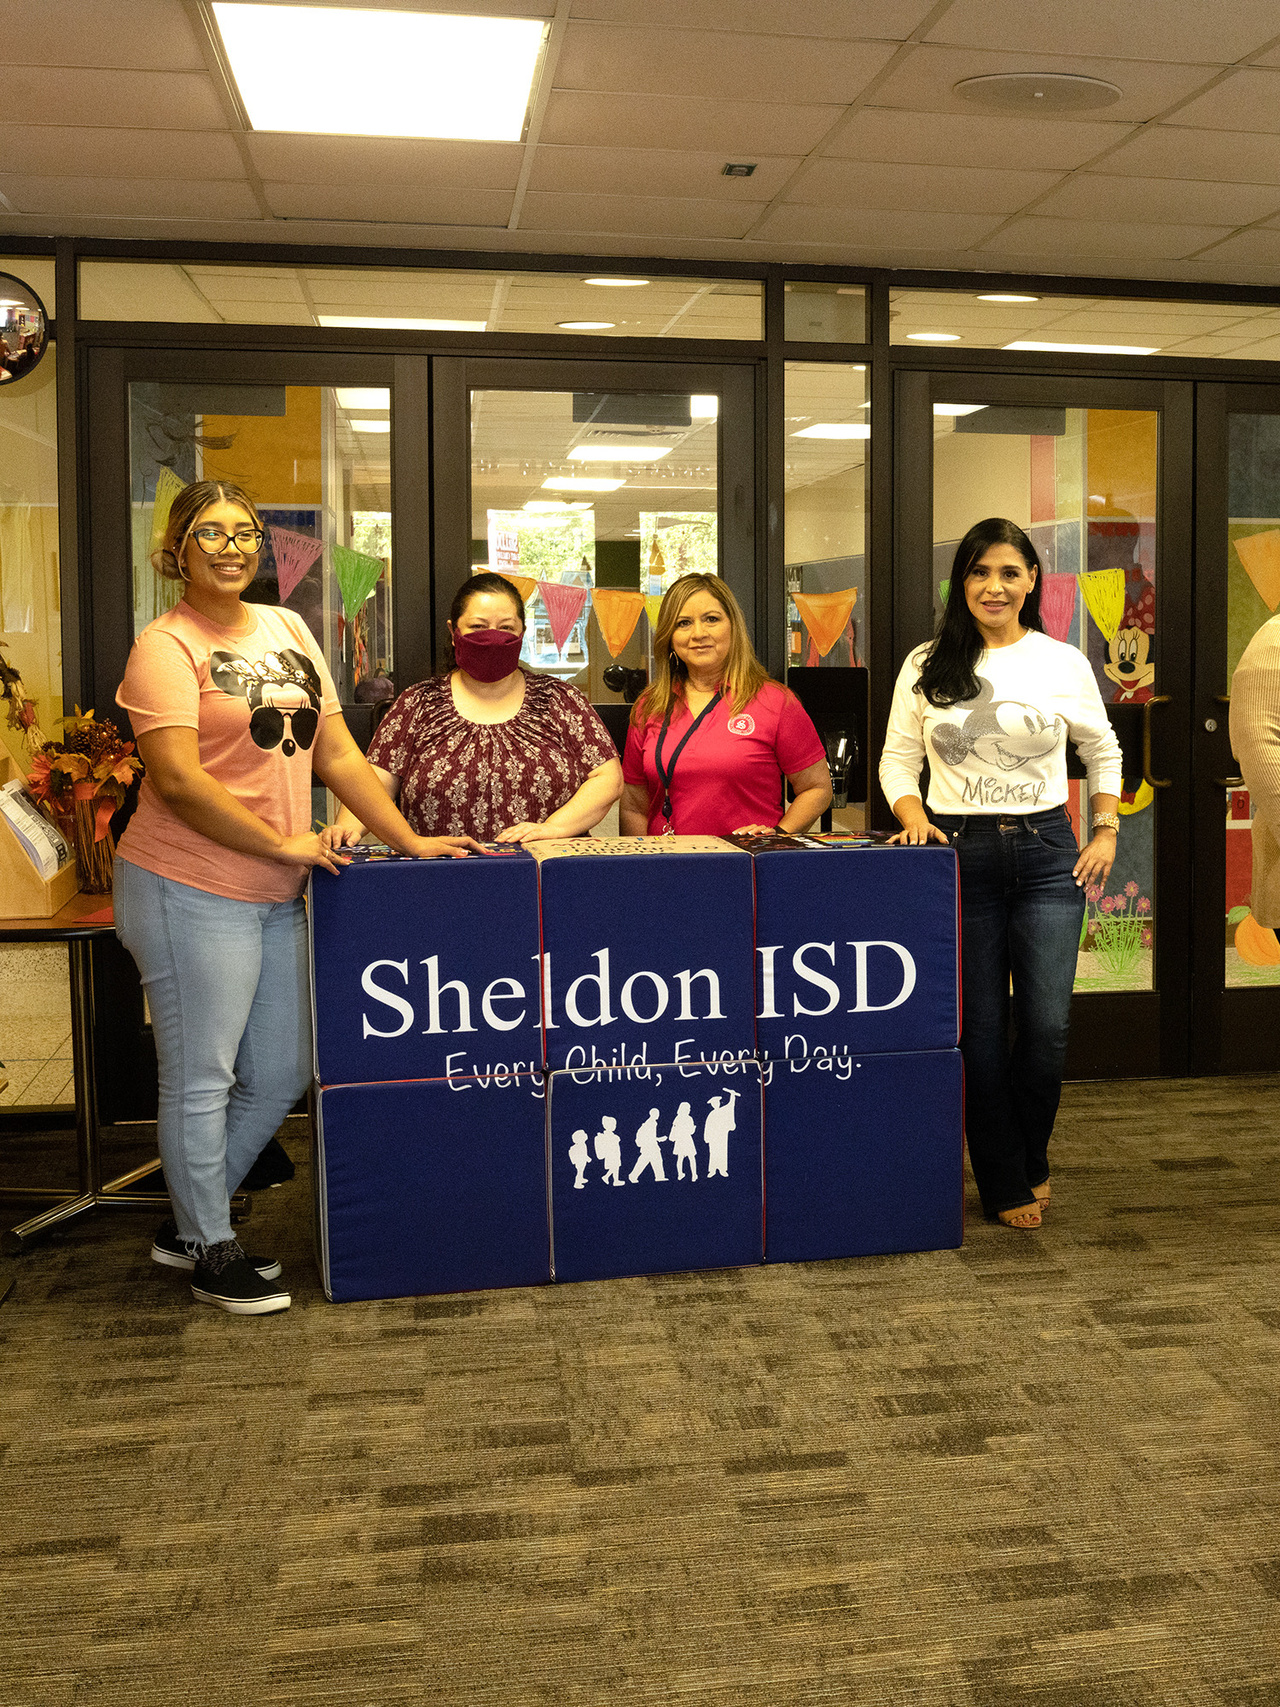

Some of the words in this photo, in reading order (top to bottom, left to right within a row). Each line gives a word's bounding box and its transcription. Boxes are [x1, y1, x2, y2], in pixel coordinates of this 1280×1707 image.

[360, 946, 728, 1040] Sheldon
[754, 939, 918, 1020] ISD
[445, 1050, 548, 1098] Every
[564, 1040, 665, 1088] Child,
[673, 1038, 771, 1085] Every
[783, 1033, 863, 1081] Day.
